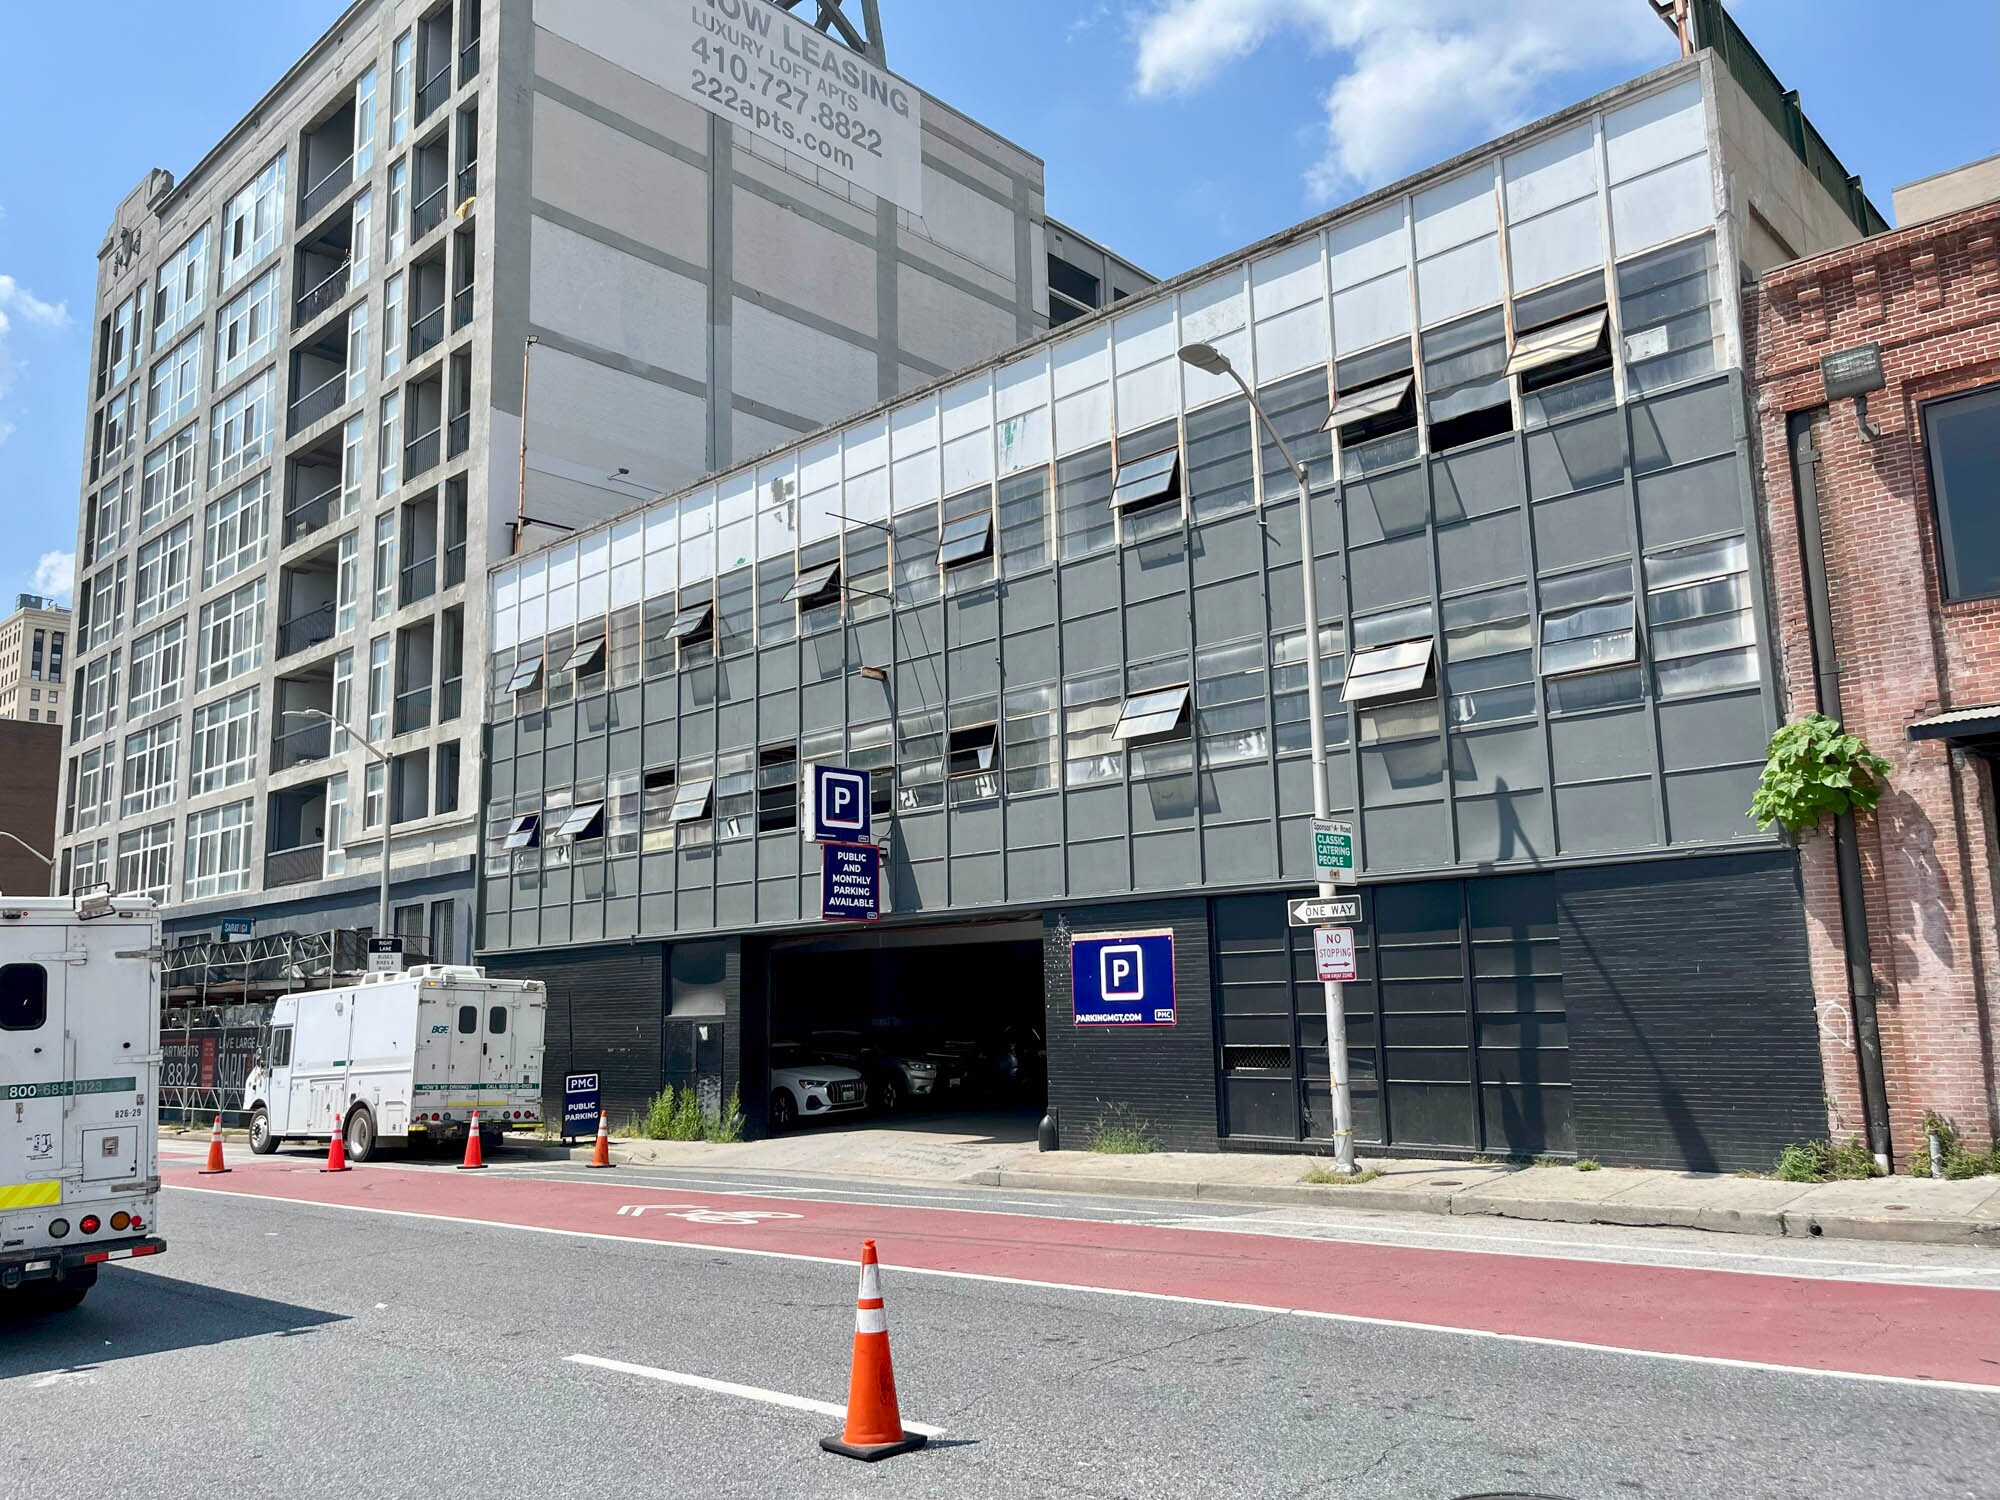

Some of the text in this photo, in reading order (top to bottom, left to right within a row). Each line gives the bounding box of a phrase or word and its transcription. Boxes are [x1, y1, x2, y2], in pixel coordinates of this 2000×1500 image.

[692, 6, 858, 112] LUXURY LOFT APTS
[706, 0, 910, 119] OW LEASING
[691, 36, 883, 158] 410.727.8822
[691, 68, 854, 170] 222apts.com
[834, 786, 851, 814] P
[1317, 834, 1345, 845] CLASSIC
[1318, 845, 1350, 856] CATERING
[837, 851, 867, 862] PUBLIC
[1319, 855, 1344, 866] PEOPLE
[843, 864, 861, 873] AND
[832, 874, 872, 885] MONTHLY
[833, 886, 870, 896] PARKING
[829, 897, 875, 908] AVAILABLE
[1305, 904, 1353, 917] ONE WAY
[1326, 933, 1341, 944] NO
[1320, 947, 1352, 958] STOPPING
[1112, 959, 1130, 987] P
[1075, 1013, 1142, 1022] PARKINGMGT.COM
[432, 1025, 449, 1034] BGE
[218, 1037, 235, 1049] LVE
[236, 1037, 256, 1049] LARGE
[9, 1080, 103, 1098] 800-685-0123
[571, 1078, 594, 1089] PMC
[568, 1102, 596, 1111] PUBLIC
[115, 1108, 142, 1118] 826-29
[565, 1111, 599, 1121] PARKING
